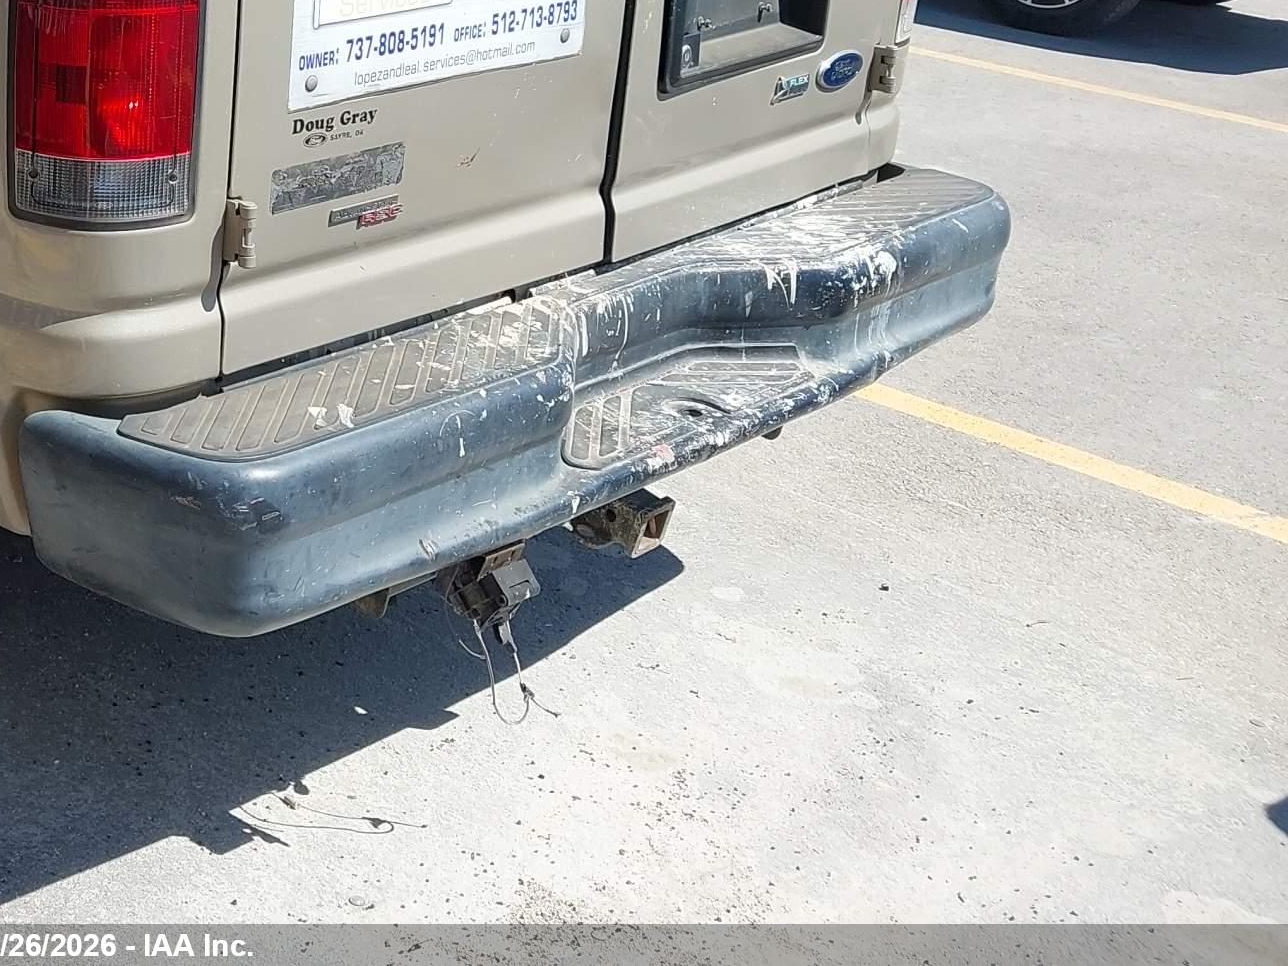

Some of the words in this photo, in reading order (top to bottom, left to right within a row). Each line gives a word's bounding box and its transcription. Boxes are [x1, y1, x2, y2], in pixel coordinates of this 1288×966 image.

[299, 47, 340, 71] OWNER:
[346, 22, 445, 62] 737-808-5191
[453, 21, 487, 42] OFFICE:
[491, 0, 578, 35] 512-713-8793
[292, 117, 335, 135] Doug
[340, 108, 378, 128] Gray
